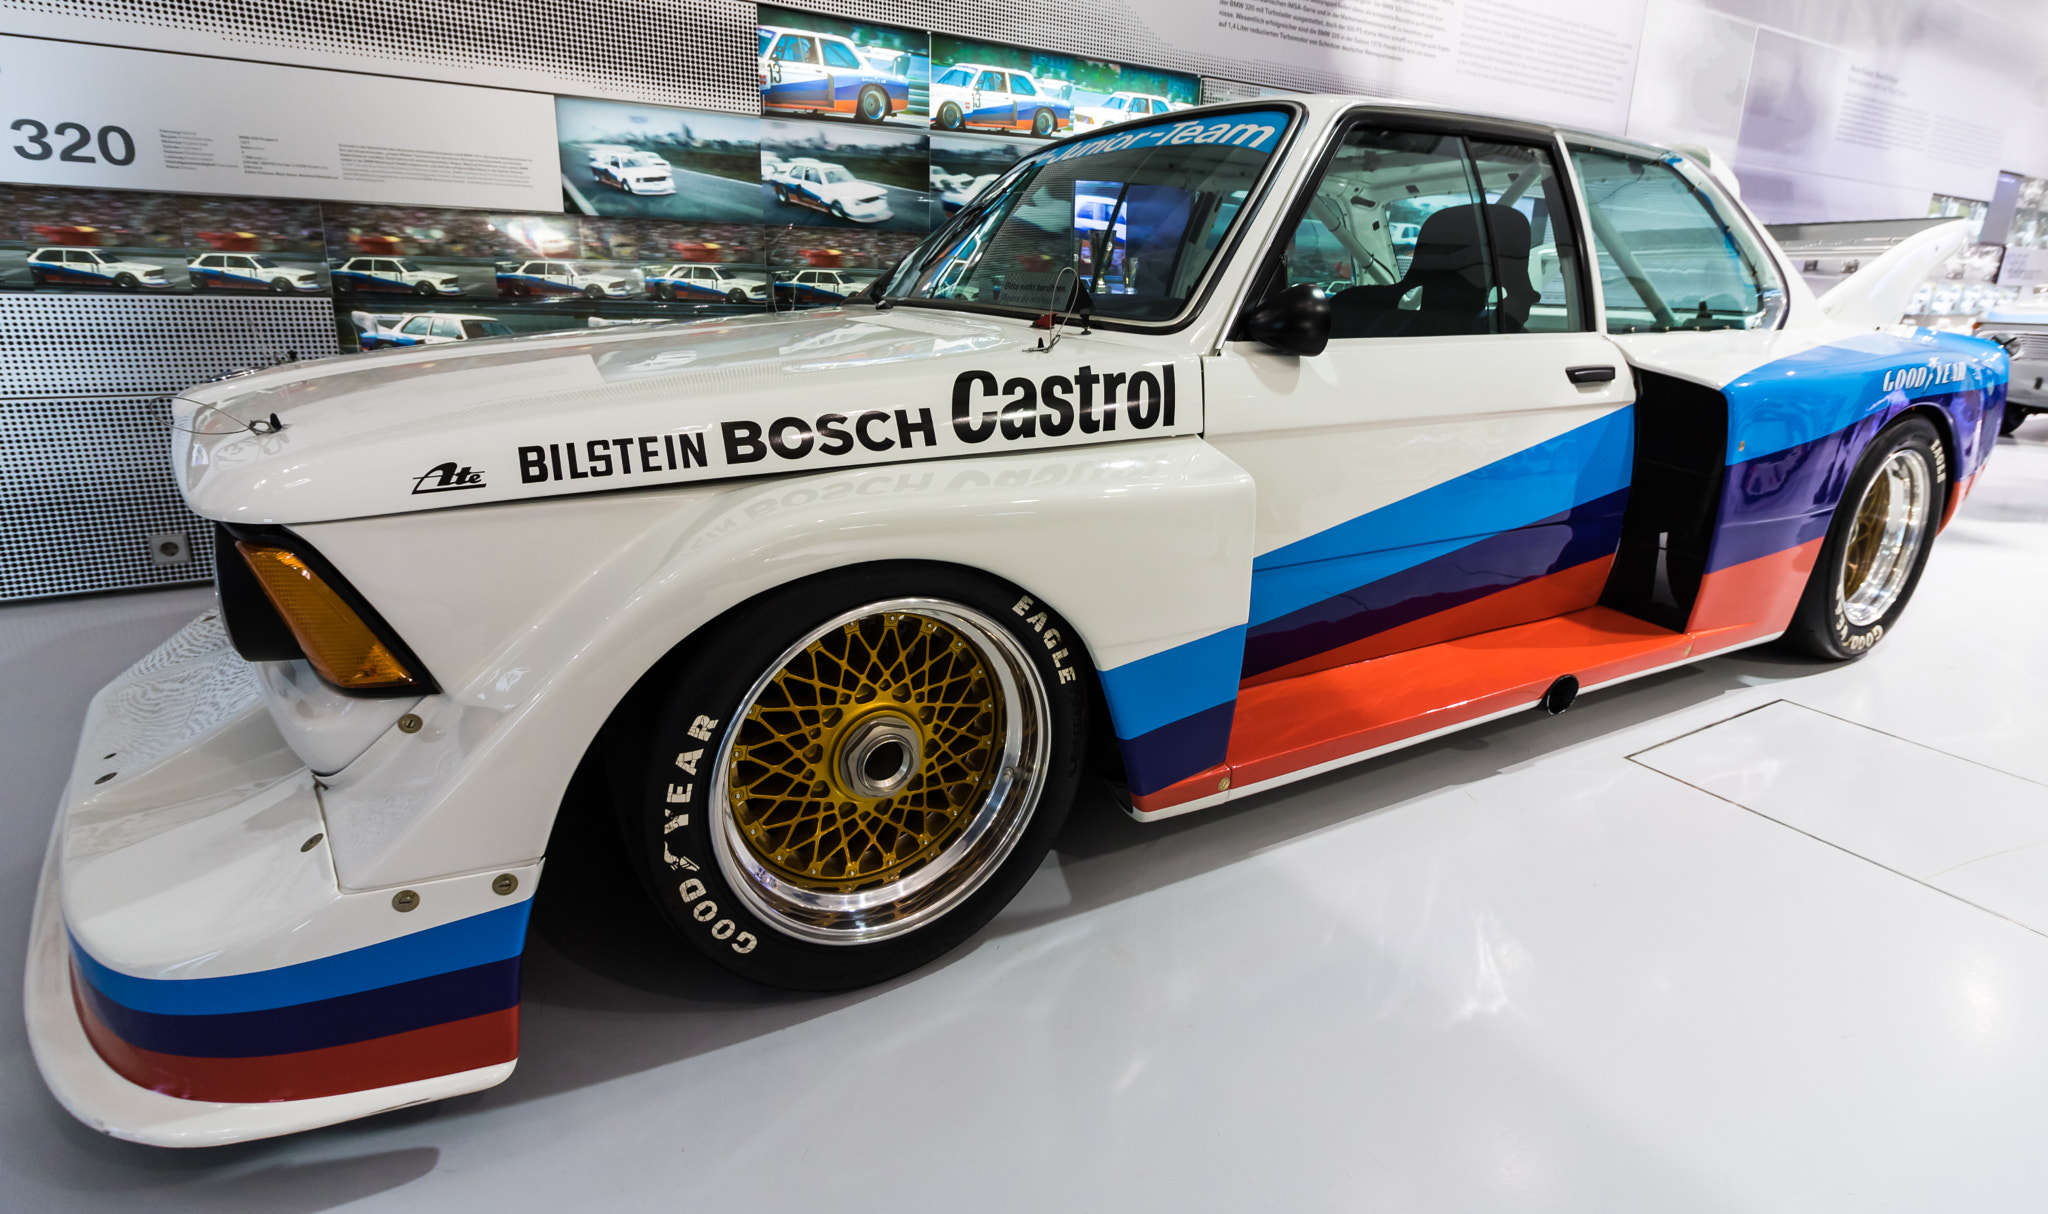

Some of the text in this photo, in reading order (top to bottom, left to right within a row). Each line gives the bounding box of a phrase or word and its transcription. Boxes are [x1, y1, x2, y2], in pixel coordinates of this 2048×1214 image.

[10, 118, 136, 167] 320
[412, 364, 1176, 495] Ate BILSTEIN BOSCH Castrol
[1931, 438, 1946, 483] EAGLE
[1012, 595, 1076, 685] EAGLE
